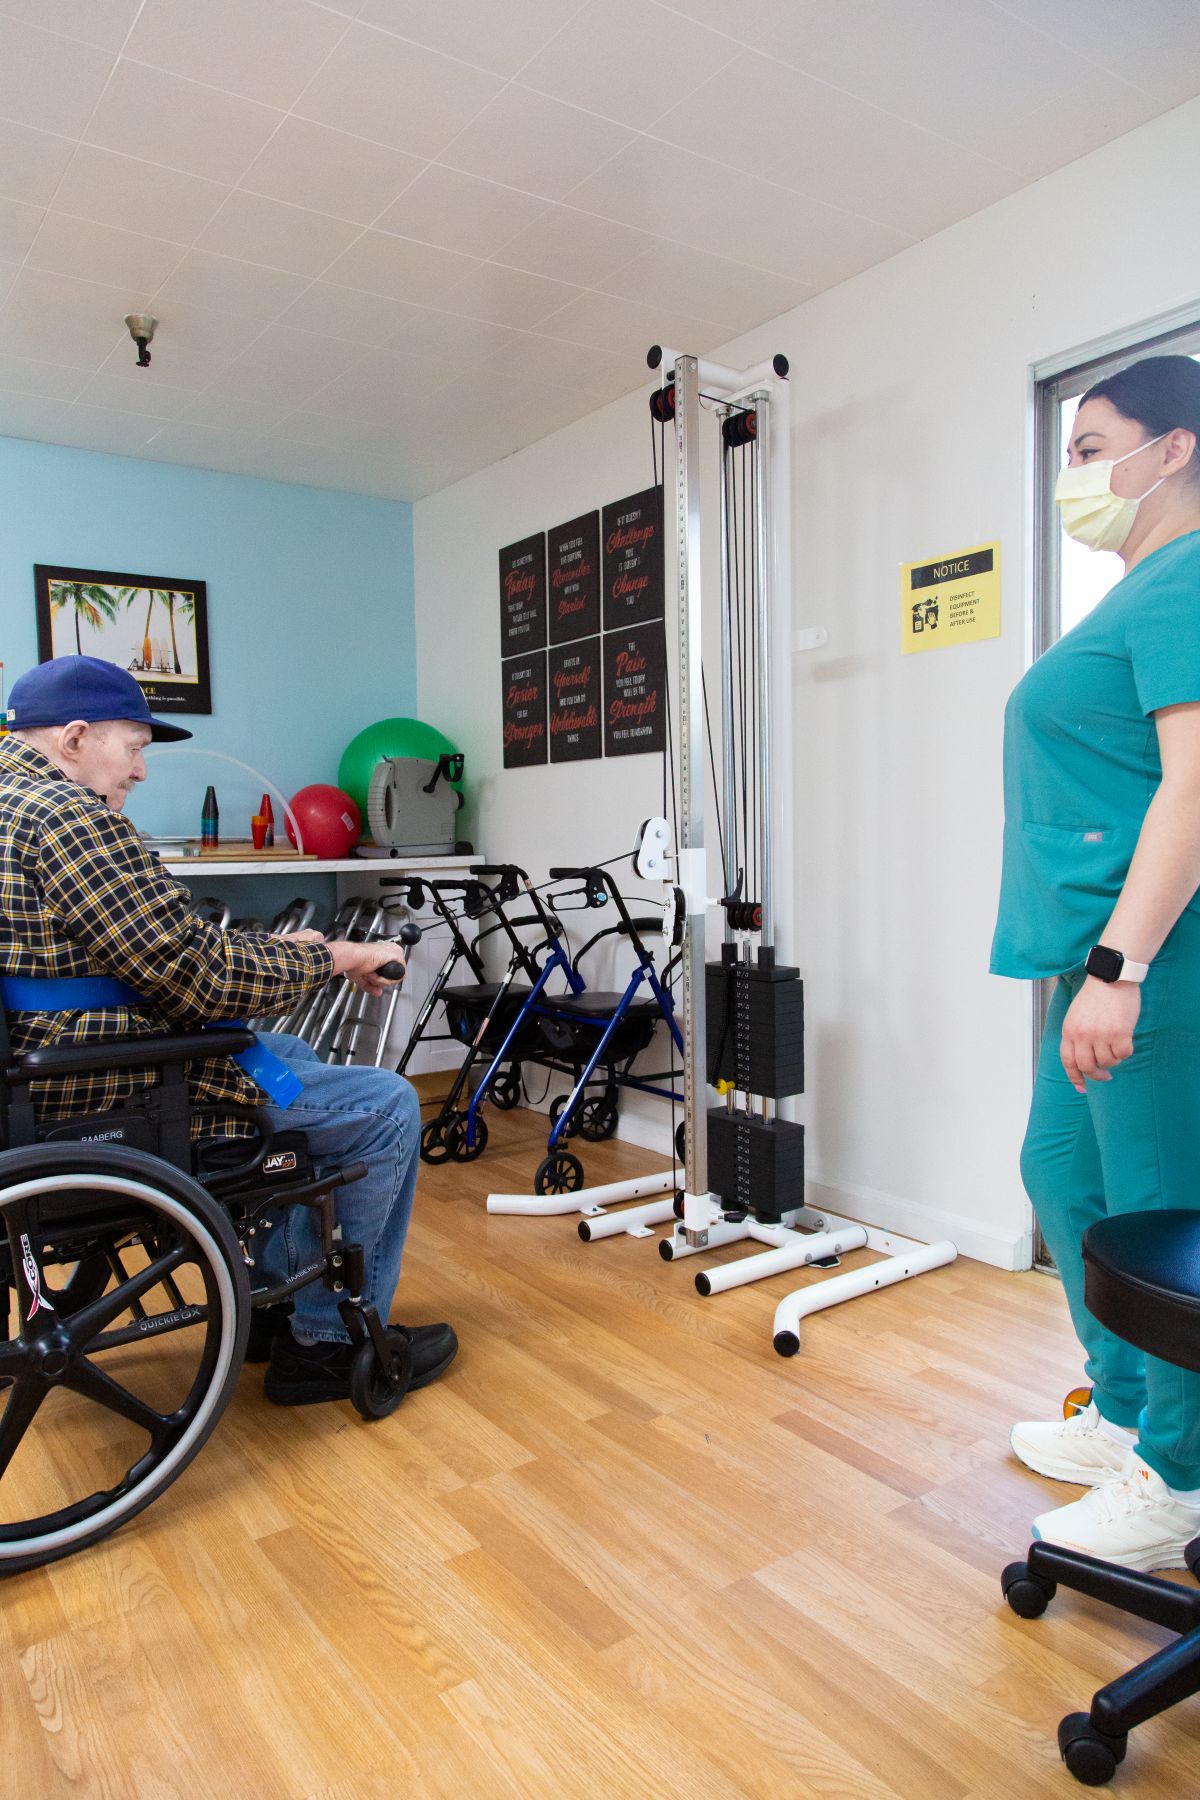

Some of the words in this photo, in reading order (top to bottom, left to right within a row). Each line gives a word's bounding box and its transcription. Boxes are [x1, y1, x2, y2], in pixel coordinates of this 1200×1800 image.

[607, 525, 656, 554] Challenge
[625, 548, 634, 558] YOU
[933, 560, 970, 579] NOTICE
[505, 570, 536, 601] Today
[612, 574, 649, 598] Change
[950, 591, 975, 602] DISINFECT
[558, 592, 588, 619] Started
[950, 599, 980, 610] EQUIPMENT
[950, 610, 968, 619] BEFORE
[950, 619, 966, 627] AFTER
[616, 650, 646, 677] Pain
[554, 666, 591, 698] Yourself
[506, 682, 538, 707] Easier
[609, 689, 657, 725] Strength
[503, 721, 544, 749] Stronger
[265, 1156, 285, 1168] JAY
[140, 1315, 180, 1331] QUICKIE
